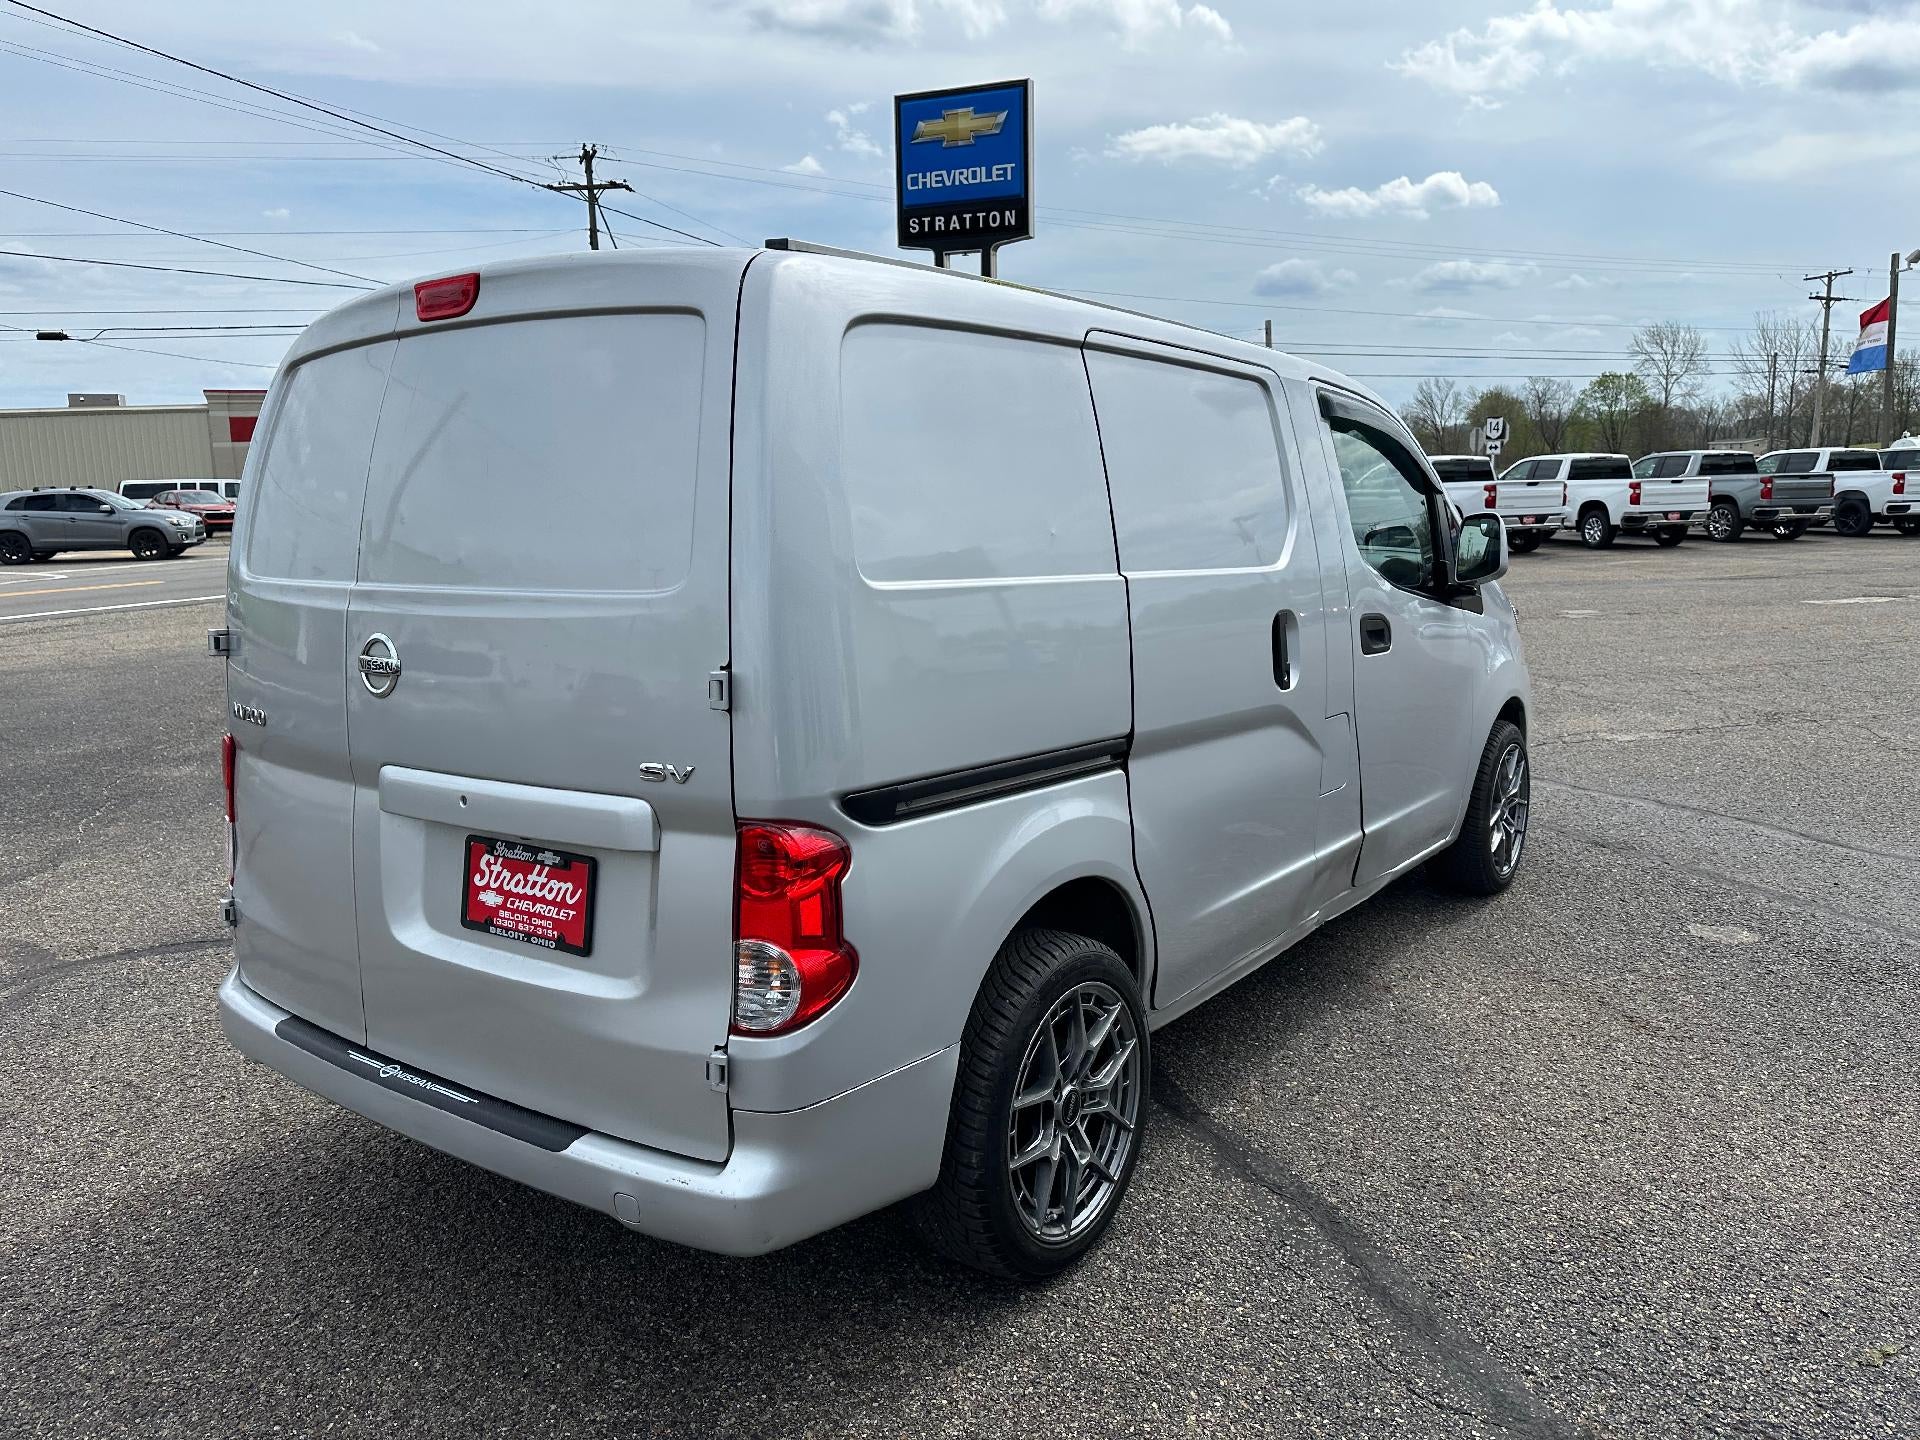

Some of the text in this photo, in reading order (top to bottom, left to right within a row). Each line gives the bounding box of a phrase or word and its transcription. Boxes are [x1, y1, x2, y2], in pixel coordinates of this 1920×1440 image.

[907, 163, 1016, 190] CHEVROLET
[909, 209, 1016, 233] STRATTON
[1489, 421, 1500, 433] 14
[359, 657, 393, 672] NISSAN
[639, 762, 696, 784] SV
[493, 840, 536, 862] Stratton
[473, 853, 583, 905] Stratton
[498, 909, 553, 929] BELOIT, OHIO
[506, 897, 577, 921] CHEVROLET
[489, 926, 556, 949] BELOIT, OHIO
[493, 917, 558, 939] (330) 537-3151
[394, 1070, 435, 1090] NISSAN
